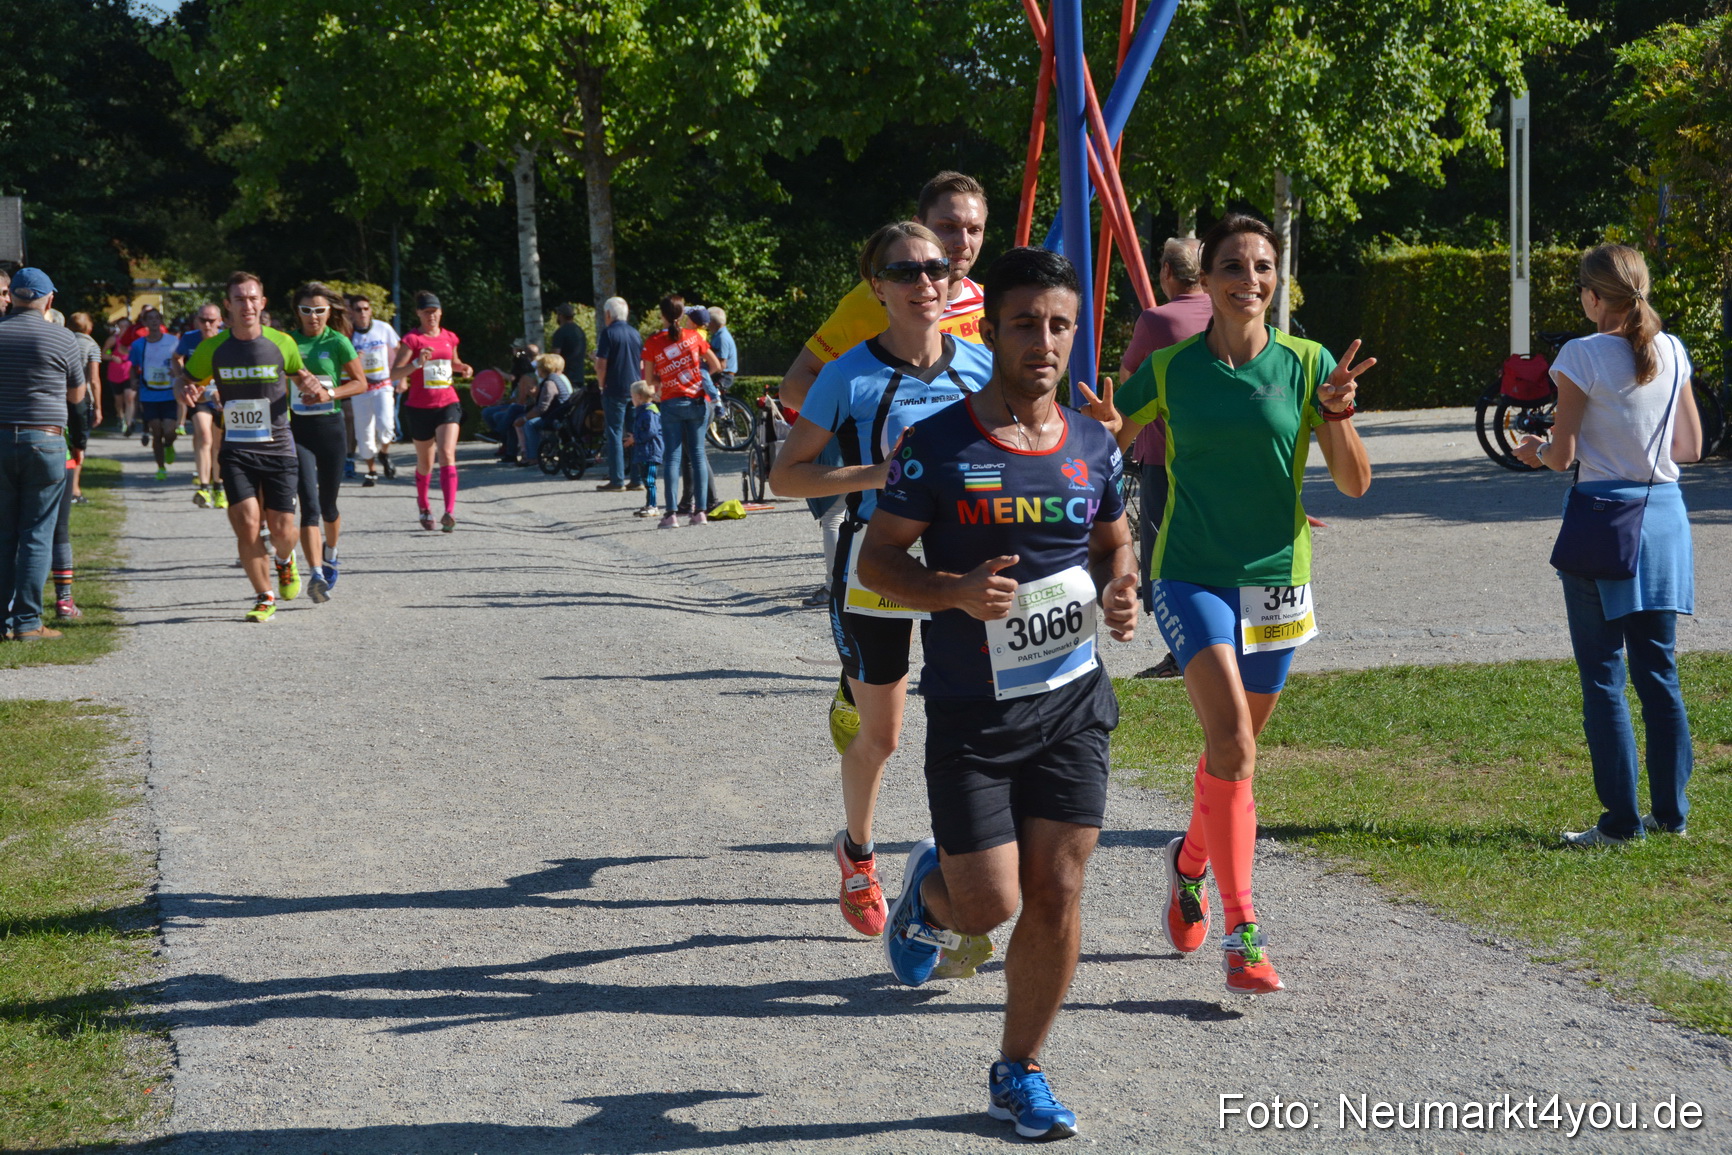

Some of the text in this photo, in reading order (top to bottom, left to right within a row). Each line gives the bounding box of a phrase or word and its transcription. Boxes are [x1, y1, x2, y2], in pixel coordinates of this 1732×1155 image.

[218, 365, 278, 380] BOCK
[1250, 383, 1288, 398] AOK
[230, 410, 263, 424] 3102
[957, 495, 1101, 525] MENSCH
[1018, 582, 1066, 607] BOCK
[1263, 584, 1306, 611] 347
[1005, 600, 1083, 652] 3066
[1260, 614, 1282, 622] PARTL
[1018, 640, 1073, 663] PARTL Neumarkt
